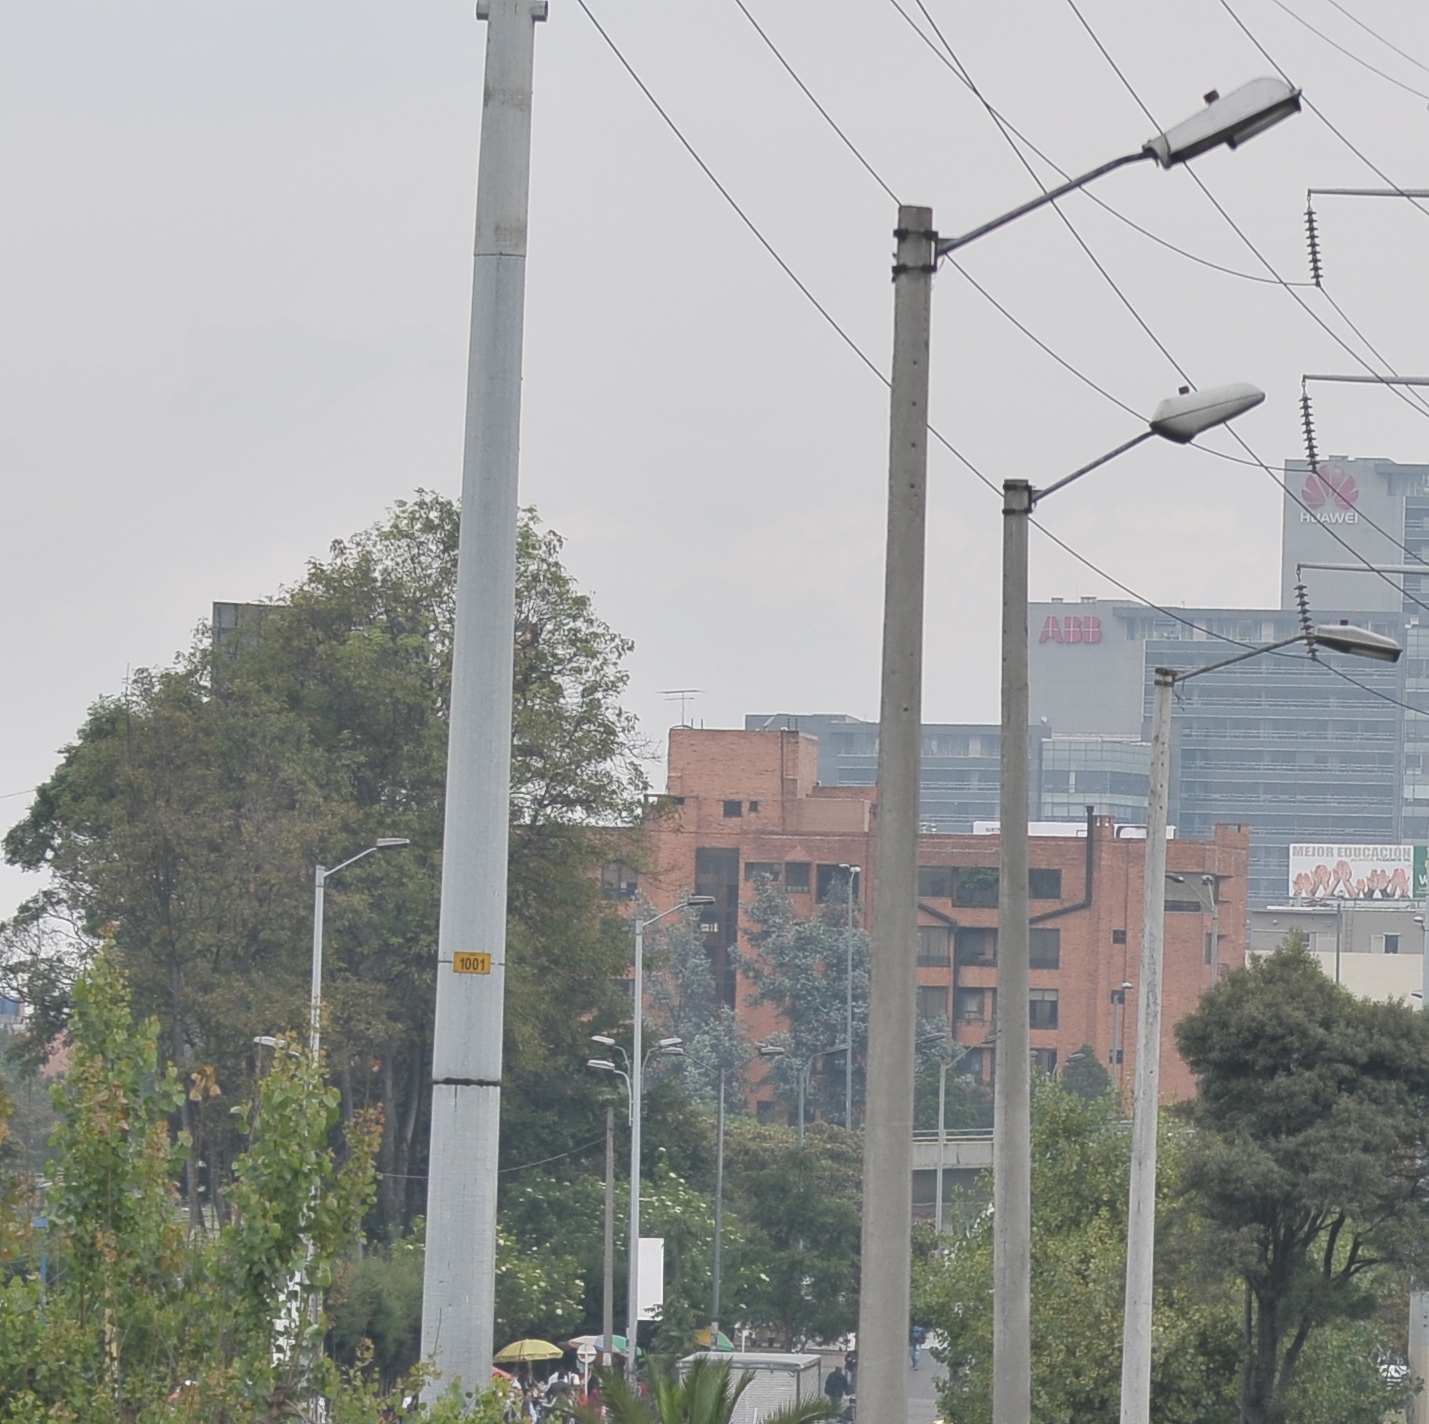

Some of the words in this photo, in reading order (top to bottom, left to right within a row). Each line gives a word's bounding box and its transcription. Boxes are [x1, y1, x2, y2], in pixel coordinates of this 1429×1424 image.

[1300, 513, 1359, 524] HUAWEI
[1039, 616, 1102, 644] ABB
[1292, 846, 1334, 858] MEJOR
[460, 957, 486, 971] 1001
